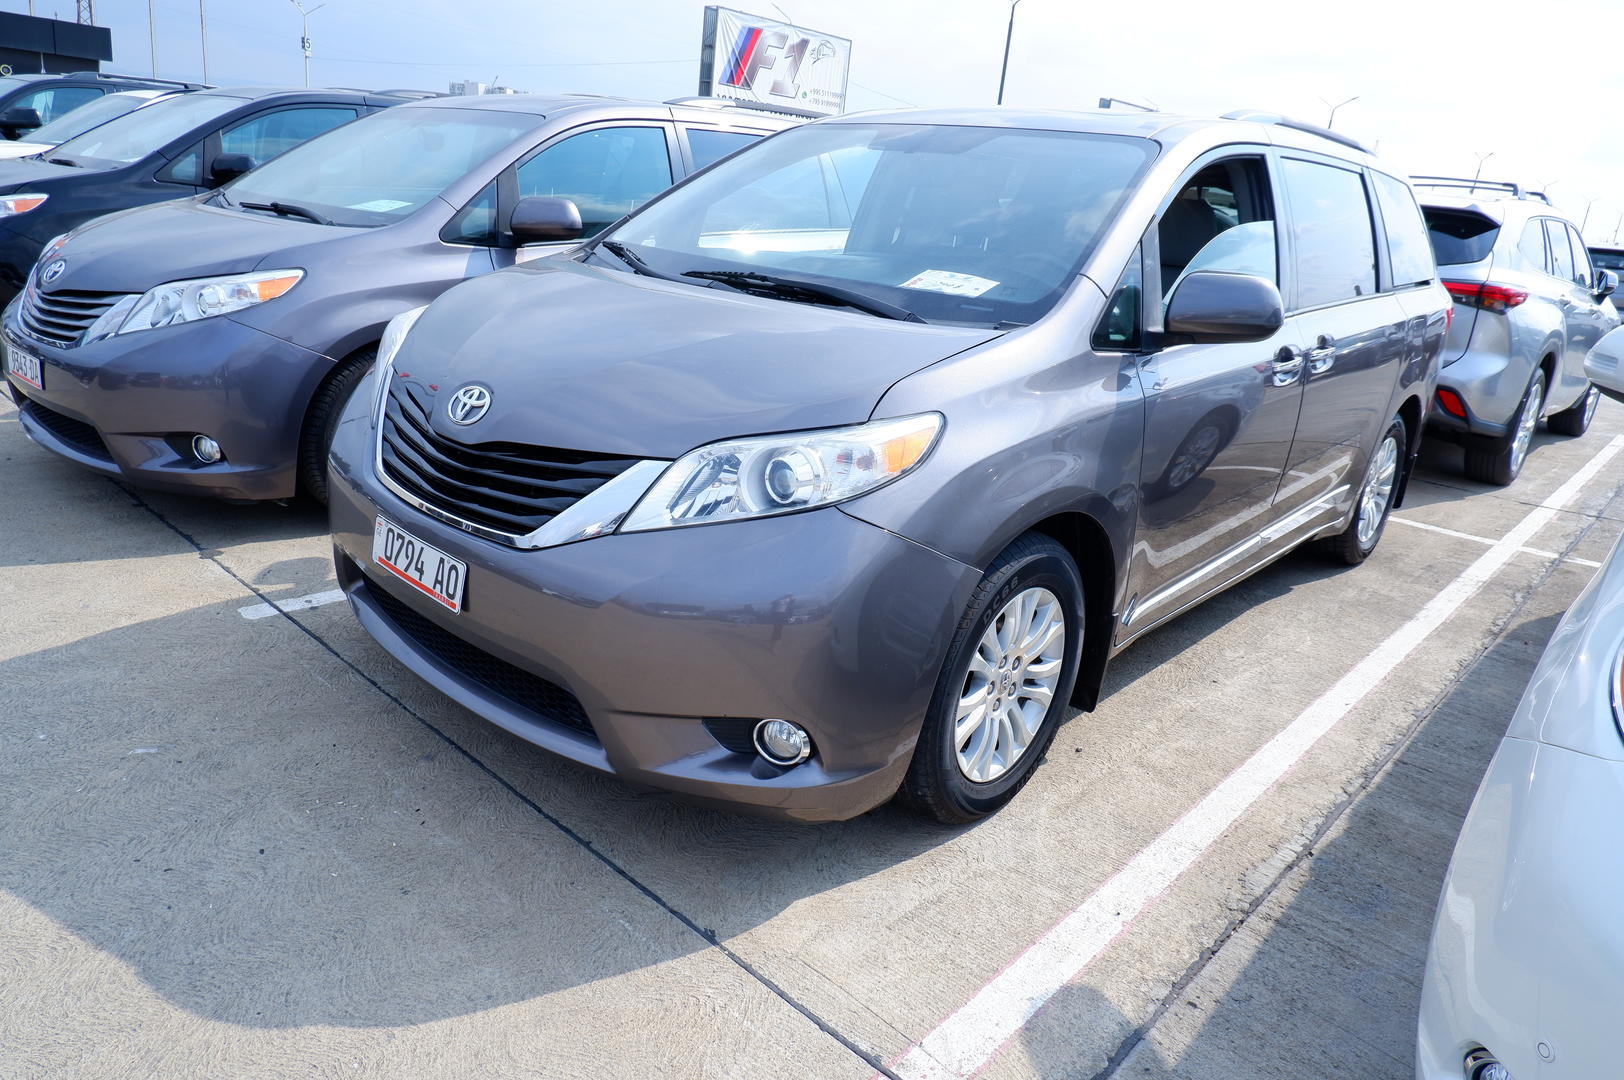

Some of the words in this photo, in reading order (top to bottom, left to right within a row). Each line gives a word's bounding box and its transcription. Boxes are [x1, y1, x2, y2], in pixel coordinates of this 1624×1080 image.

[733, 26, 811, 99] F1
[383, 526, 425, 582] 0794
[432, 556, 460, 601] AO
